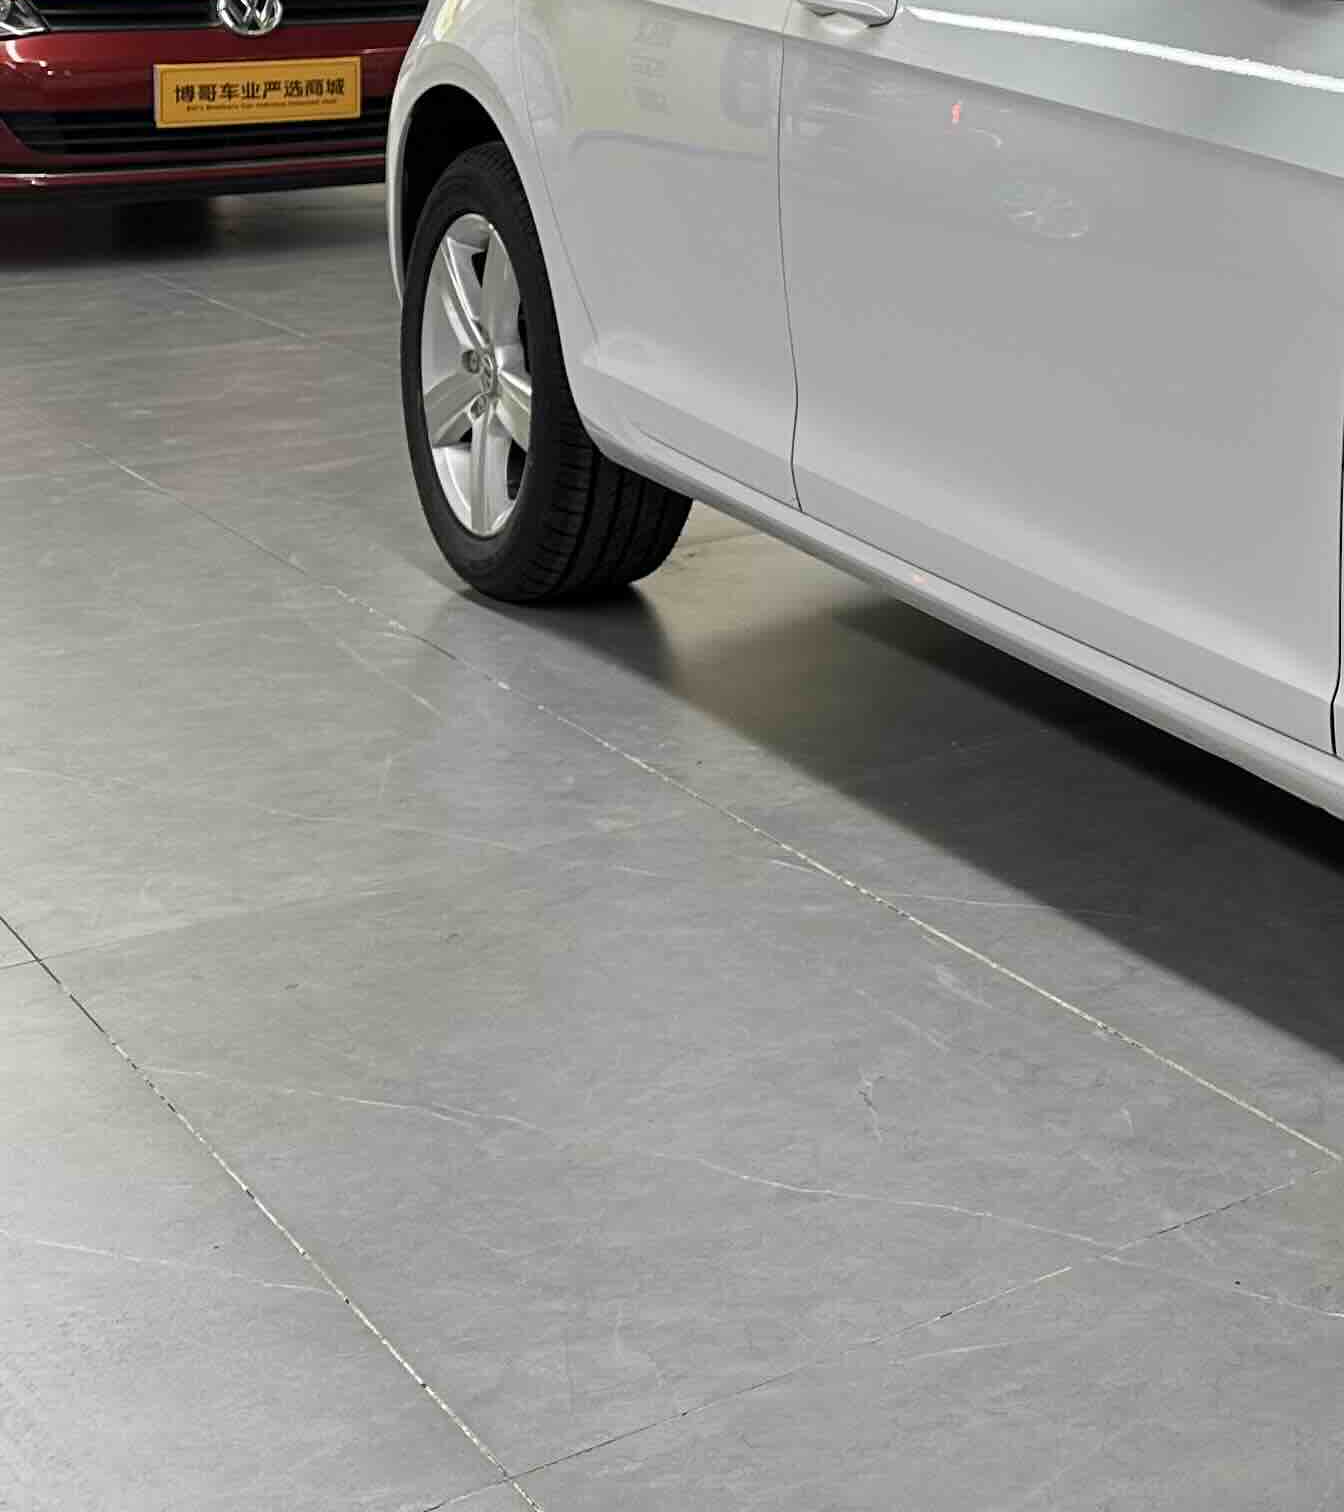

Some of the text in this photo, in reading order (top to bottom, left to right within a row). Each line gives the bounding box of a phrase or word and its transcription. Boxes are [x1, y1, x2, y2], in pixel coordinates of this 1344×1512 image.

[176, 78, 344, 103] 博哥车业严选商城
